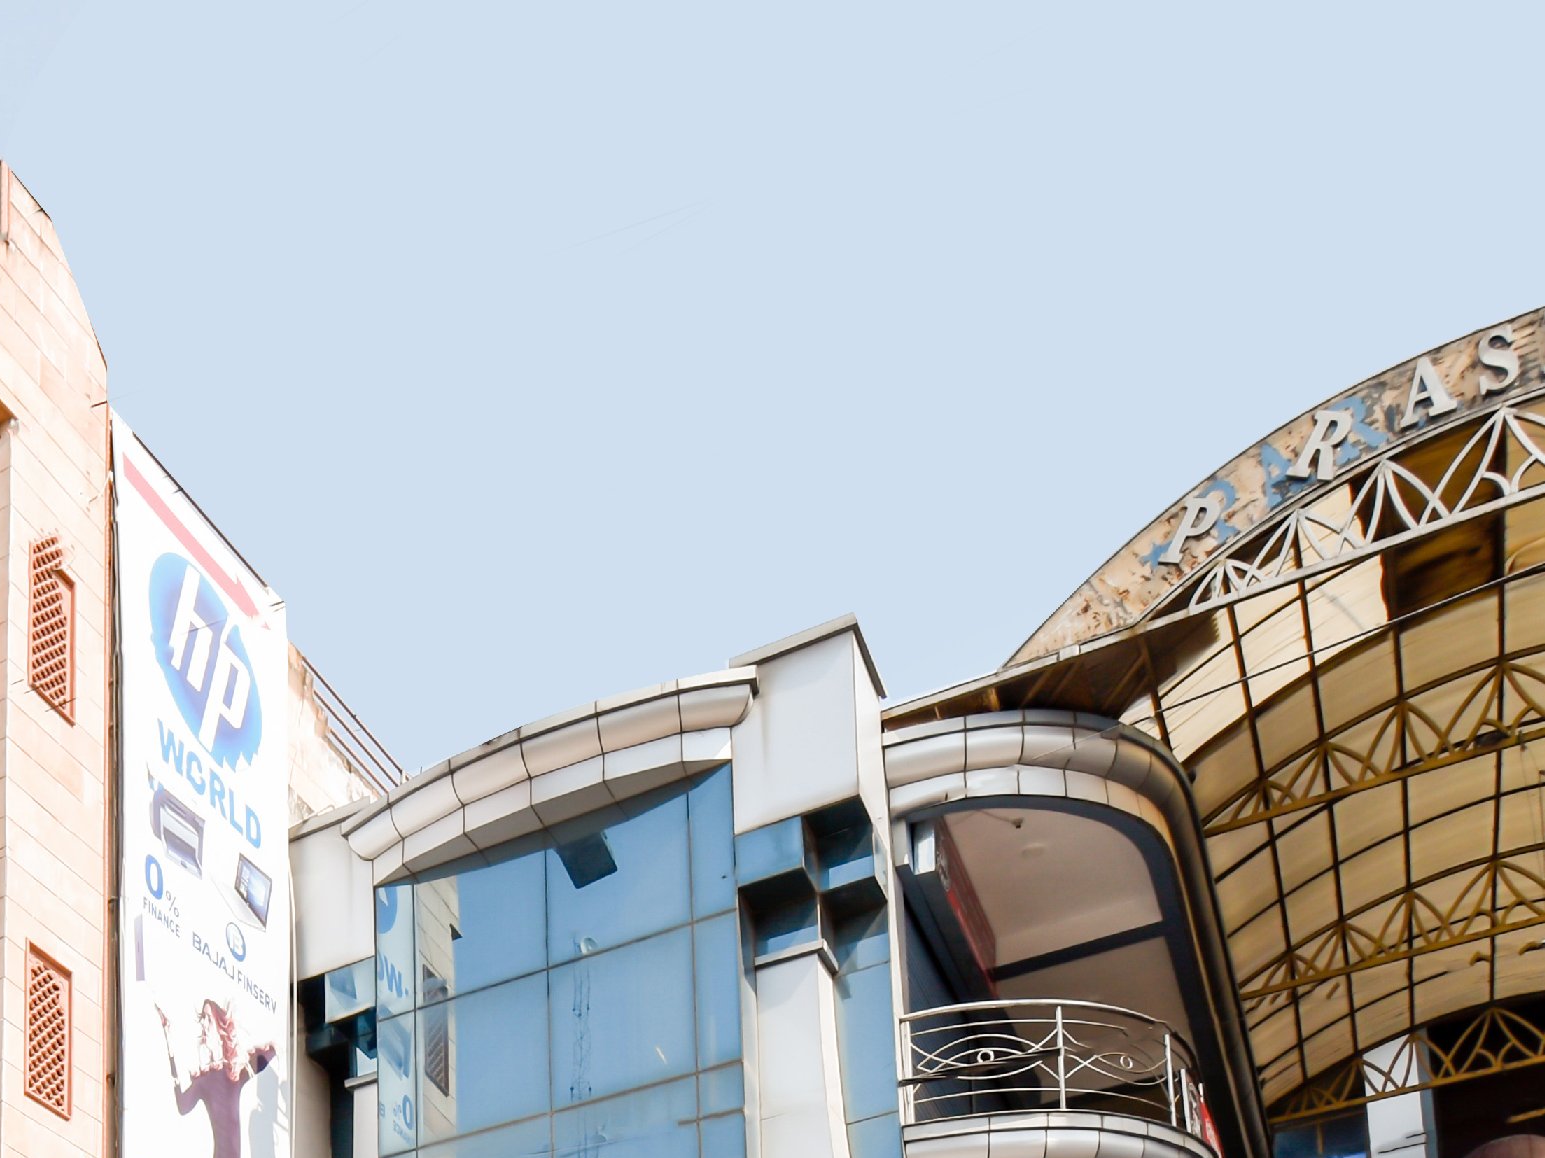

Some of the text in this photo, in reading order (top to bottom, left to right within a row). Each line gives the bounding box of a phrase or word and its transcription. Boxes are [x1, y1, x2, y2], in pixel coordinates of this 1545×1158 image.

[170, 563, 251, 751] hp
[157, 718, 261, 849] WORLD
[143, 896, 181, 938] FINANCE
[192, 931, 277, 1014] BAJAJ FINSERV
